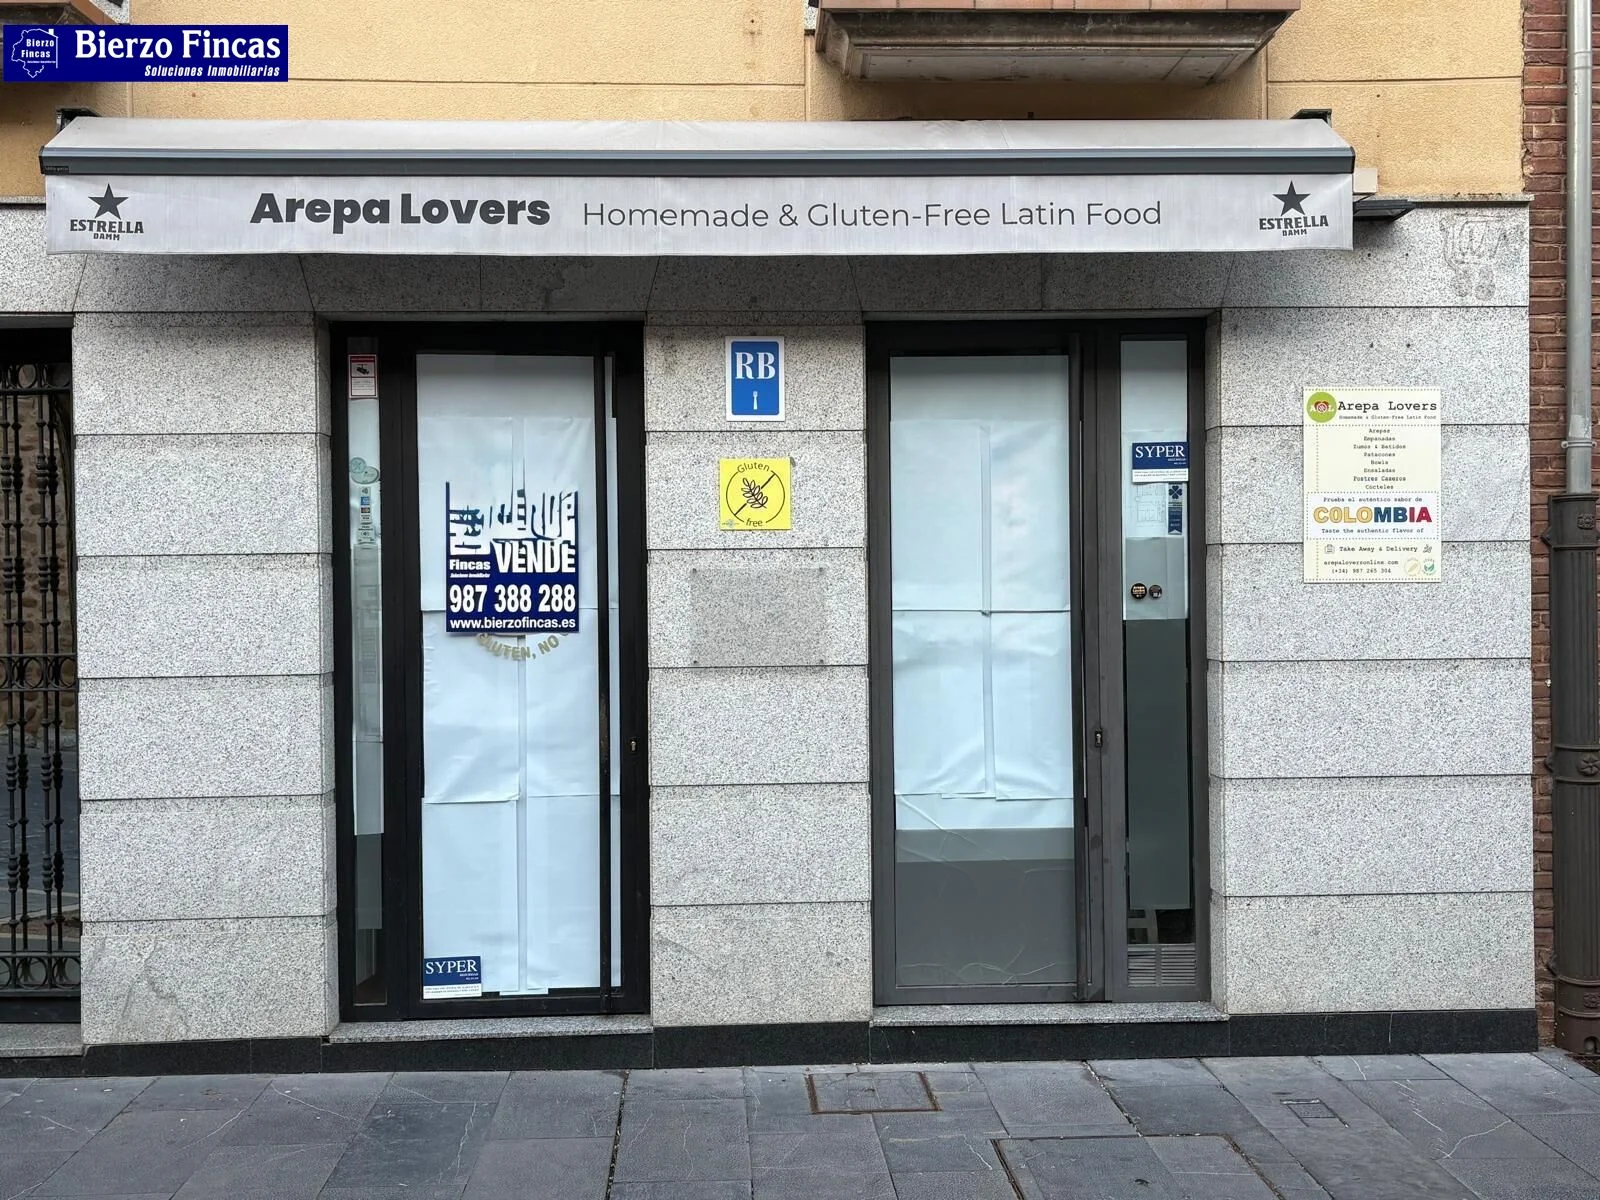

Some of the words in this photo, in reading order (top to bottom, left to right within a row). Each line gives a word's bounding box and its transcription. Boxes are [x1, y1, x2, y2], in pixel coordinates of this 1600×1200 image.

[250, 192, 391, 235] Arepa
[400, 193, 551, 225] Lovers
[583, 203, 769, 227] Homemade
[778, 203, 799, 227] &
[807, 202, 991, 227] Gluten-Free
[1002, 202, 1076, 226] Latin
[1086, 201, 1163, 225] Food
[70, 219, 144, 234] ESTRELLA
[1259, 215, 1329, 231] ESTRELLA
[93, 233, 120, 241] DAMM
[735, 352, 775, 379] RB
[1338, 401, 1380, 413] Arepa
[1388, 401, 1437, 411] Lovers
[1135, 445, 1185, 458] SYPER
[736, 461, 771, 474] Gluten
[1313, 506, 1433, 523] COLOMBIA
[746, 518, 763, 527] free
[492, 540, 576, 574] VENDE
[449, 559, 491, 571] Fincas
[450, 584, 488, 613] 987
[494, 584, 532, 613] 388
[538, 584, 576, 613] 288
[450, 616, 576, 629] www.bierzofincas.es
[537, 634, 560, 655] NO
[425, 959, 477, 974] SYPER
